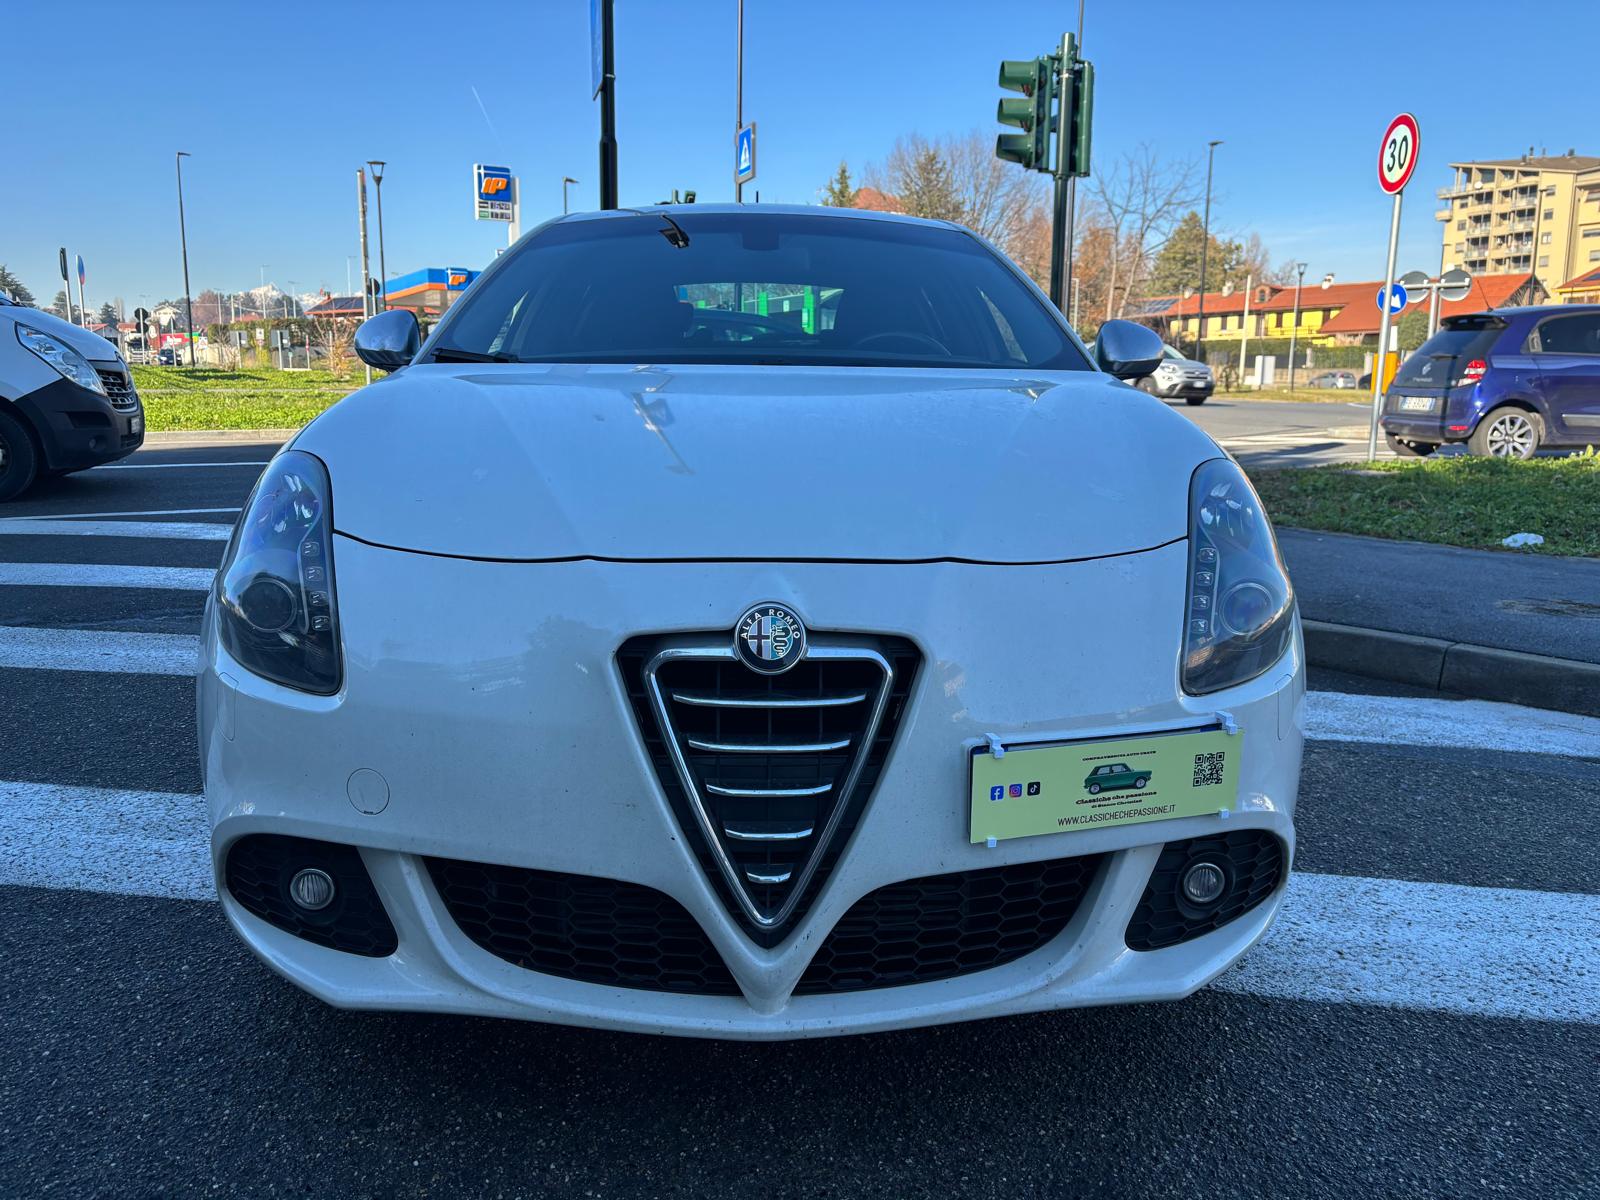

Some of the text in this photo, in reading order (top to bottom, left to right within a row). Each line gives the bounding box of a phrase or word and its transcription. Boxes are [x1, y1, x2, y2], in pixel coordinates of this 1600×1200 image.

[1387, 135, 1408, 172] 30
[481, 177, 508, 194] IP
[740, 609, 800, 639] ALFA ROMEO
[1075, 796, 1111, 805] Classiche
[1125, 791, 1157, 799] passione
[1057, 804, 1176, 827] WWW.CLASSICHECHEPASSIONE.IT
